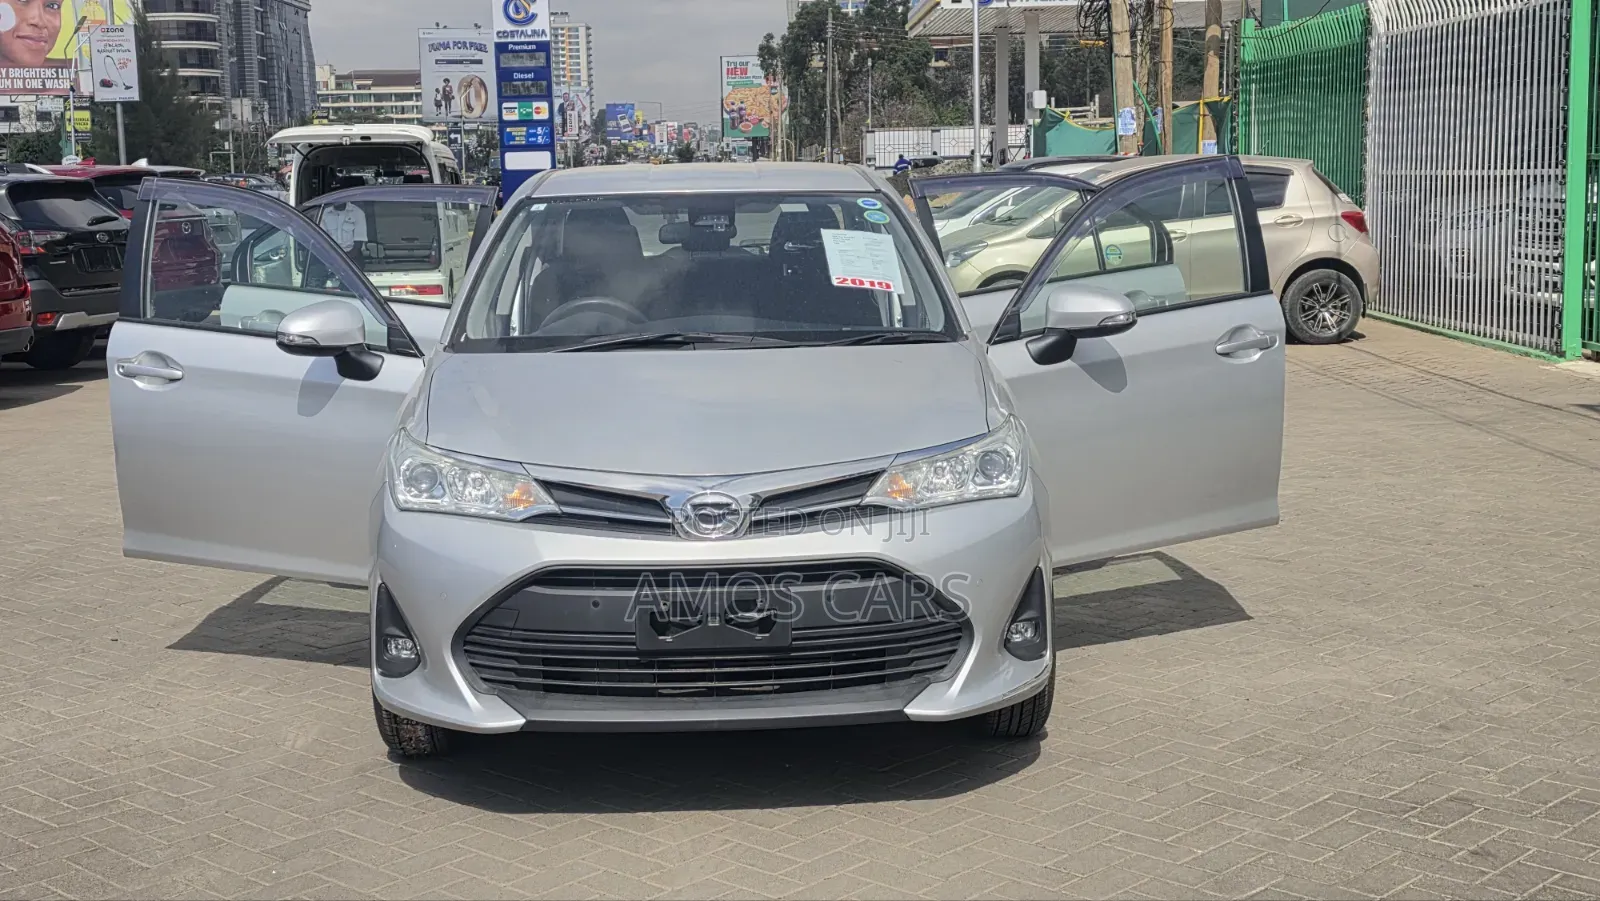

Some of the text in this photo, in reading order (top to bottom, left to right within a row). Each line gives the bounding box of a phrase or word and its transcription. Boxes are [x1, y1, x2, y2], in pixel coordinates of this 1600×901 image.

[496, 29, 547, 39] COSTALINA
[452, 41, 469, 50] FOR
[8, 68, 57, 78] BRIGHTENS
[726, 67, 748, 76] NEW
[14, 79, 23, 89] IN
[25, 79, 43, 89] ONE
[835, 277, 892, 290] 2019
